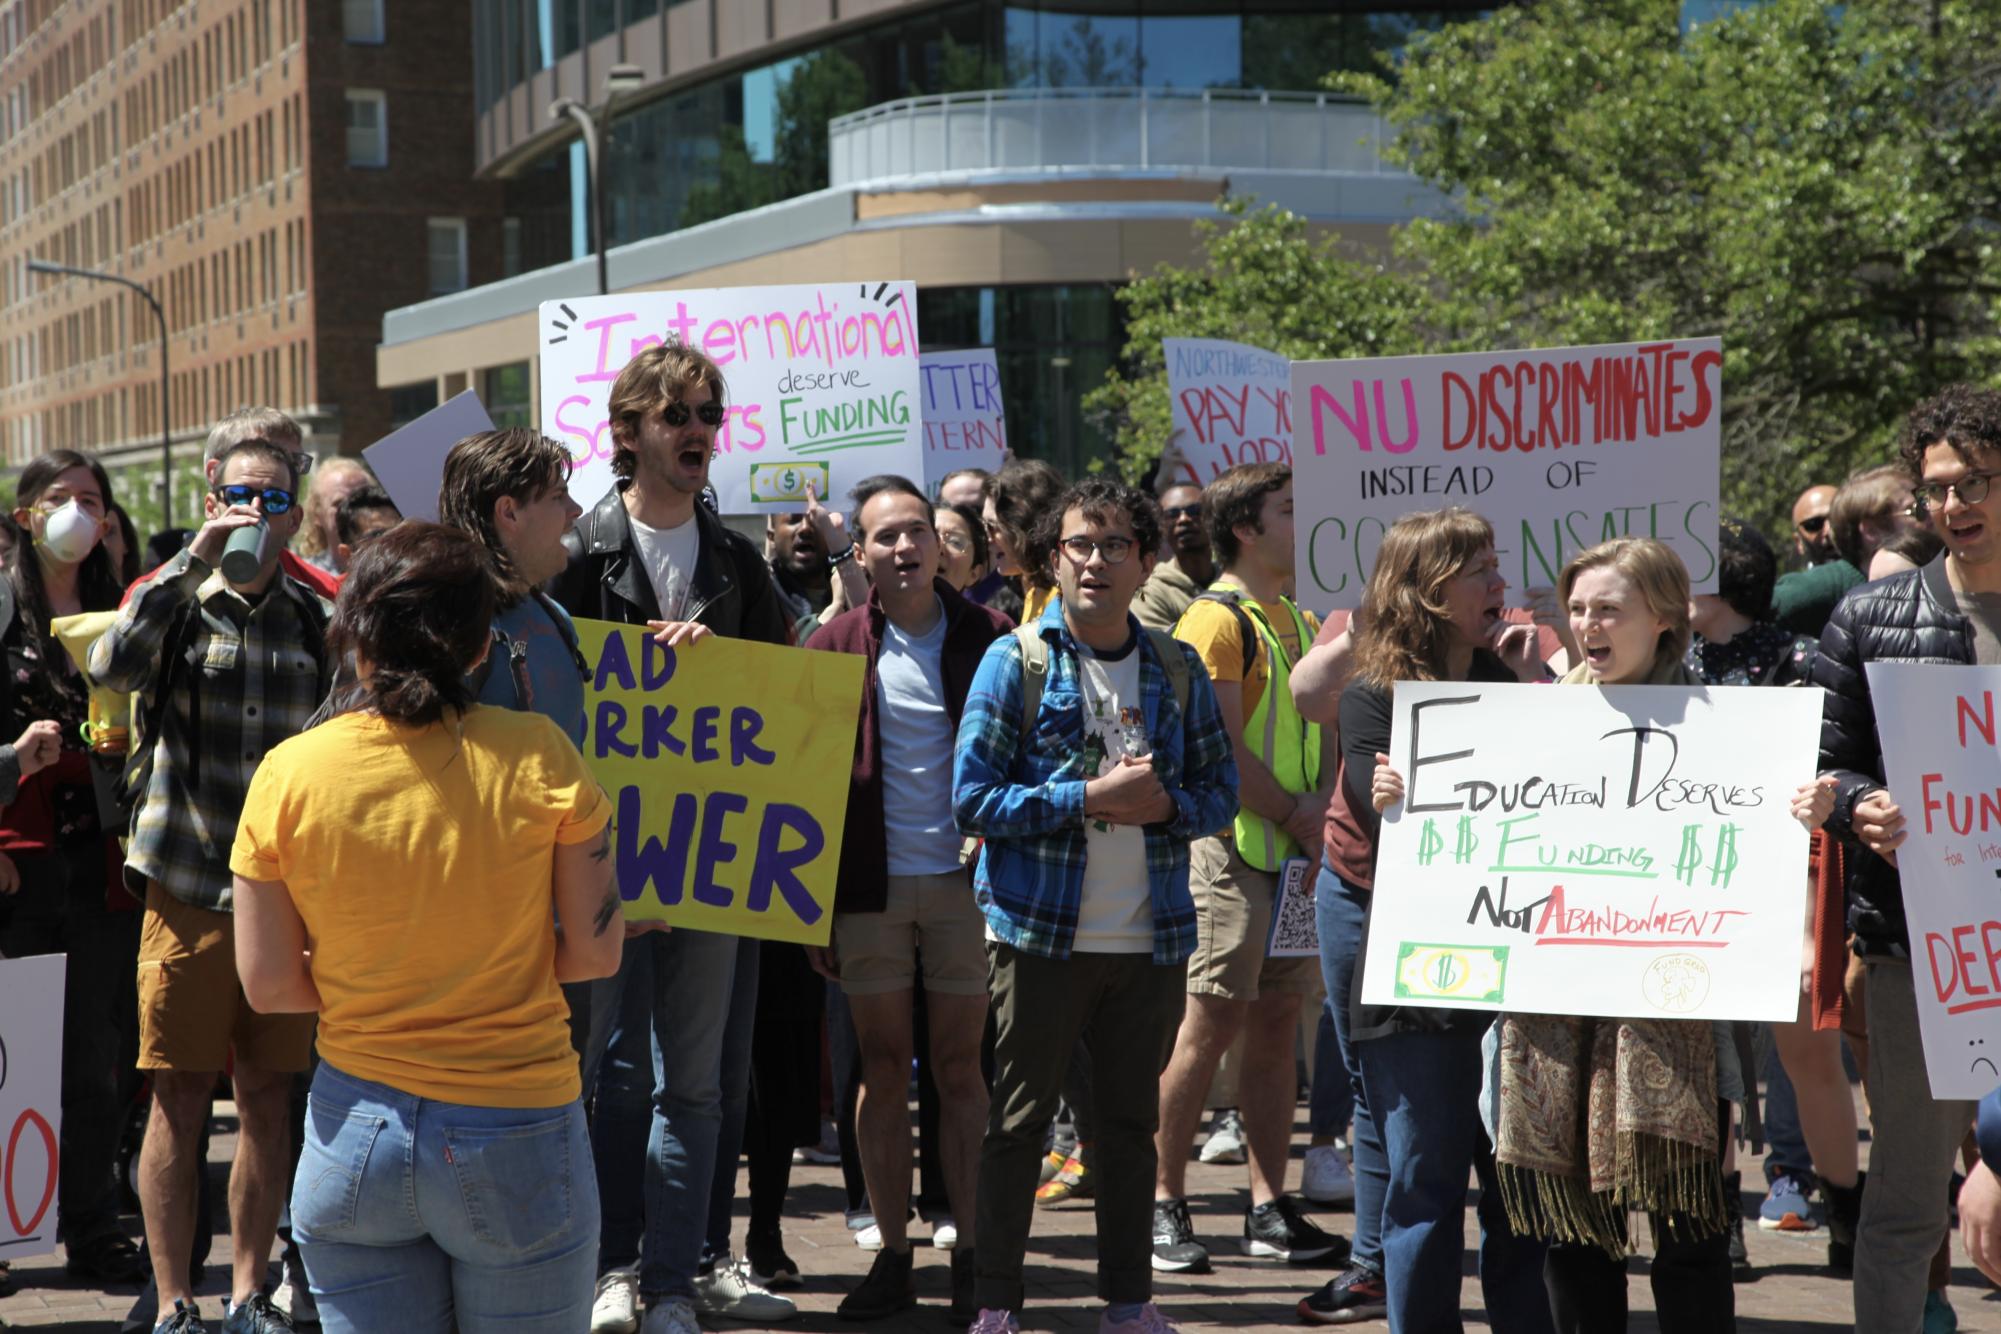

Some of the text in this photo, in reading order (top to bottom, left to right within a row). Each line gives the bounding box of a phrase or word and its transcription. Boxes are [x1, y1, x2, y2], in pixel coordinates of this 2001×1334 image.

[778, 368, 871, 395] deserve
[1309, 343, 1722, 456] NU DISCRIMINATES
[779, 390, 910, 445] FUNDING
[1180, 383, 1249, 444] PAY
[1360, 461, 1598, 499] INSTEAD OF
[582, 700, 776, 766] RKER
[1407, 694, 1765, 815] EDUCATION DESERVES
[607, 785, 825, 925] WER
[1496, 812, 1655, 872] FUNDING
[1467, 876, 1752, 937] NOT ABANDONMENT
